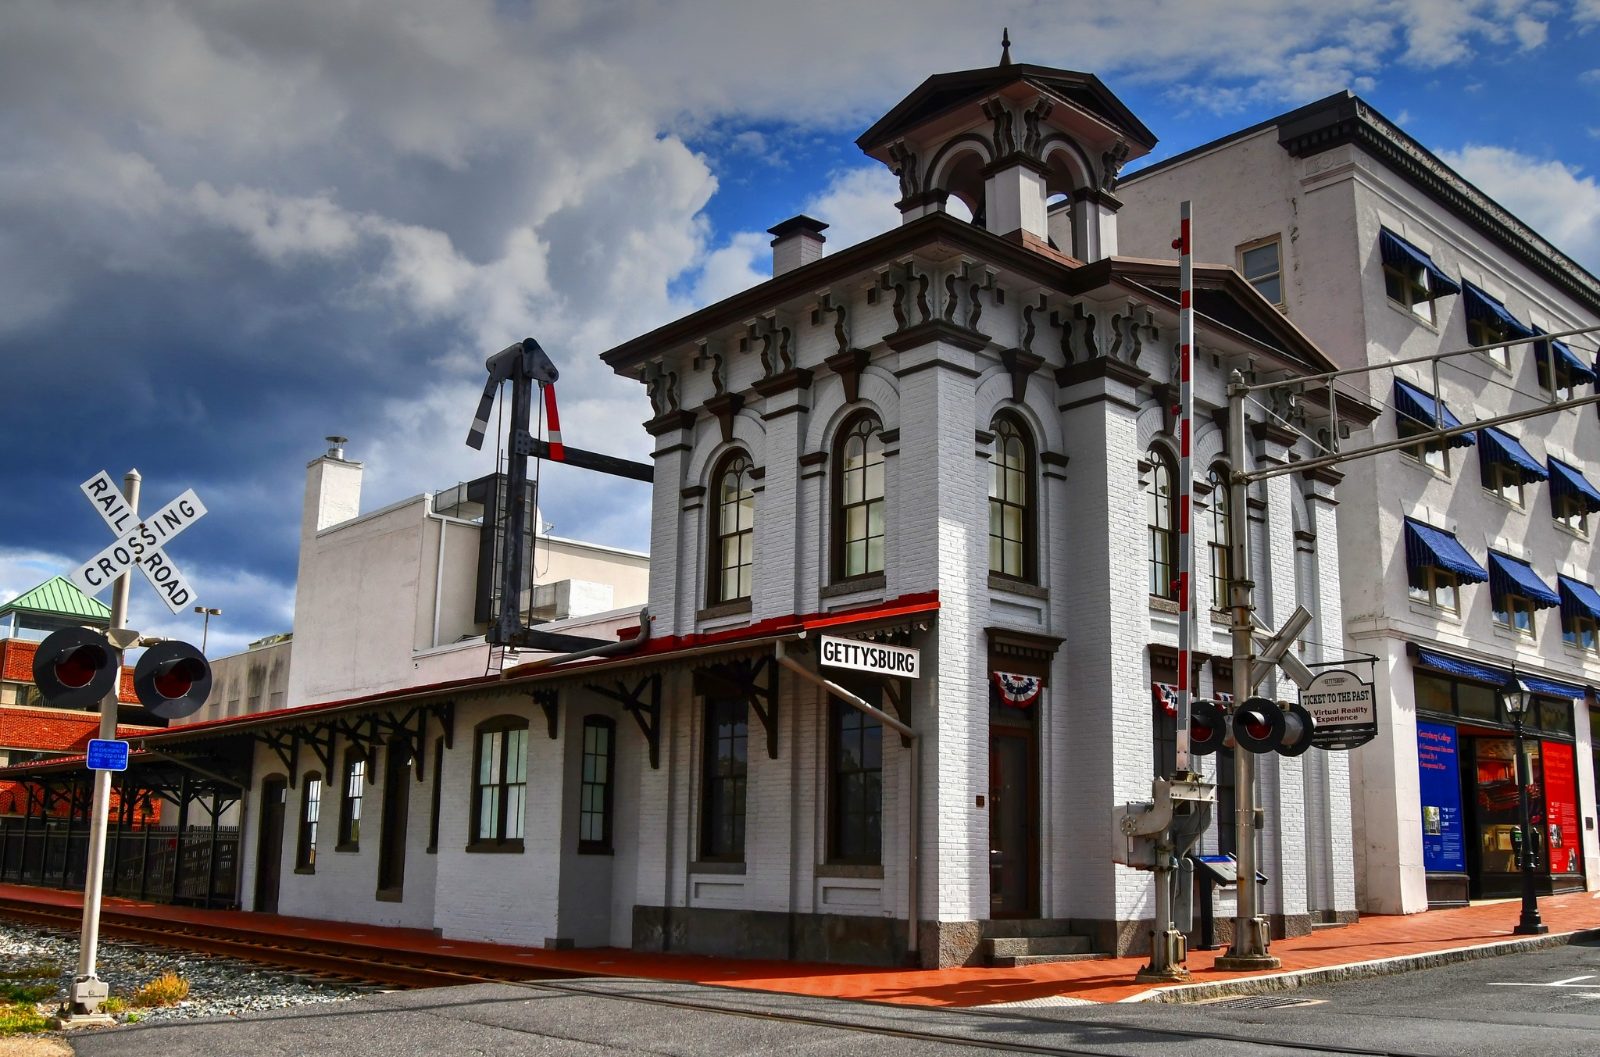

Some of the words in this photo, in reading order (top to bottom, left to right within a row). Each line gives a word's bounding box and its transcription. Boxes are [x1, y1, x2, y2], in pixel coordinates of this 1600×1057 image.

[88, 477, 130, 532] RAIL
[84, 500, 195, 586] CROSSING
[143, 552, 189, 607] ROAD
[823, 641, 915, 673] GETTYSBURG
[1303, 693, 1326, 705] TICKET
[1327, 692, 1337, 703] TO
[1337, 691, 1351, 702] THE
[1352, 690, 1369, 701] PAST
[1313, 708, 1339, 716] Virtual
[1341, 706, 1368, 714] Reality
[1316, 715, 1359, 723] Experience
